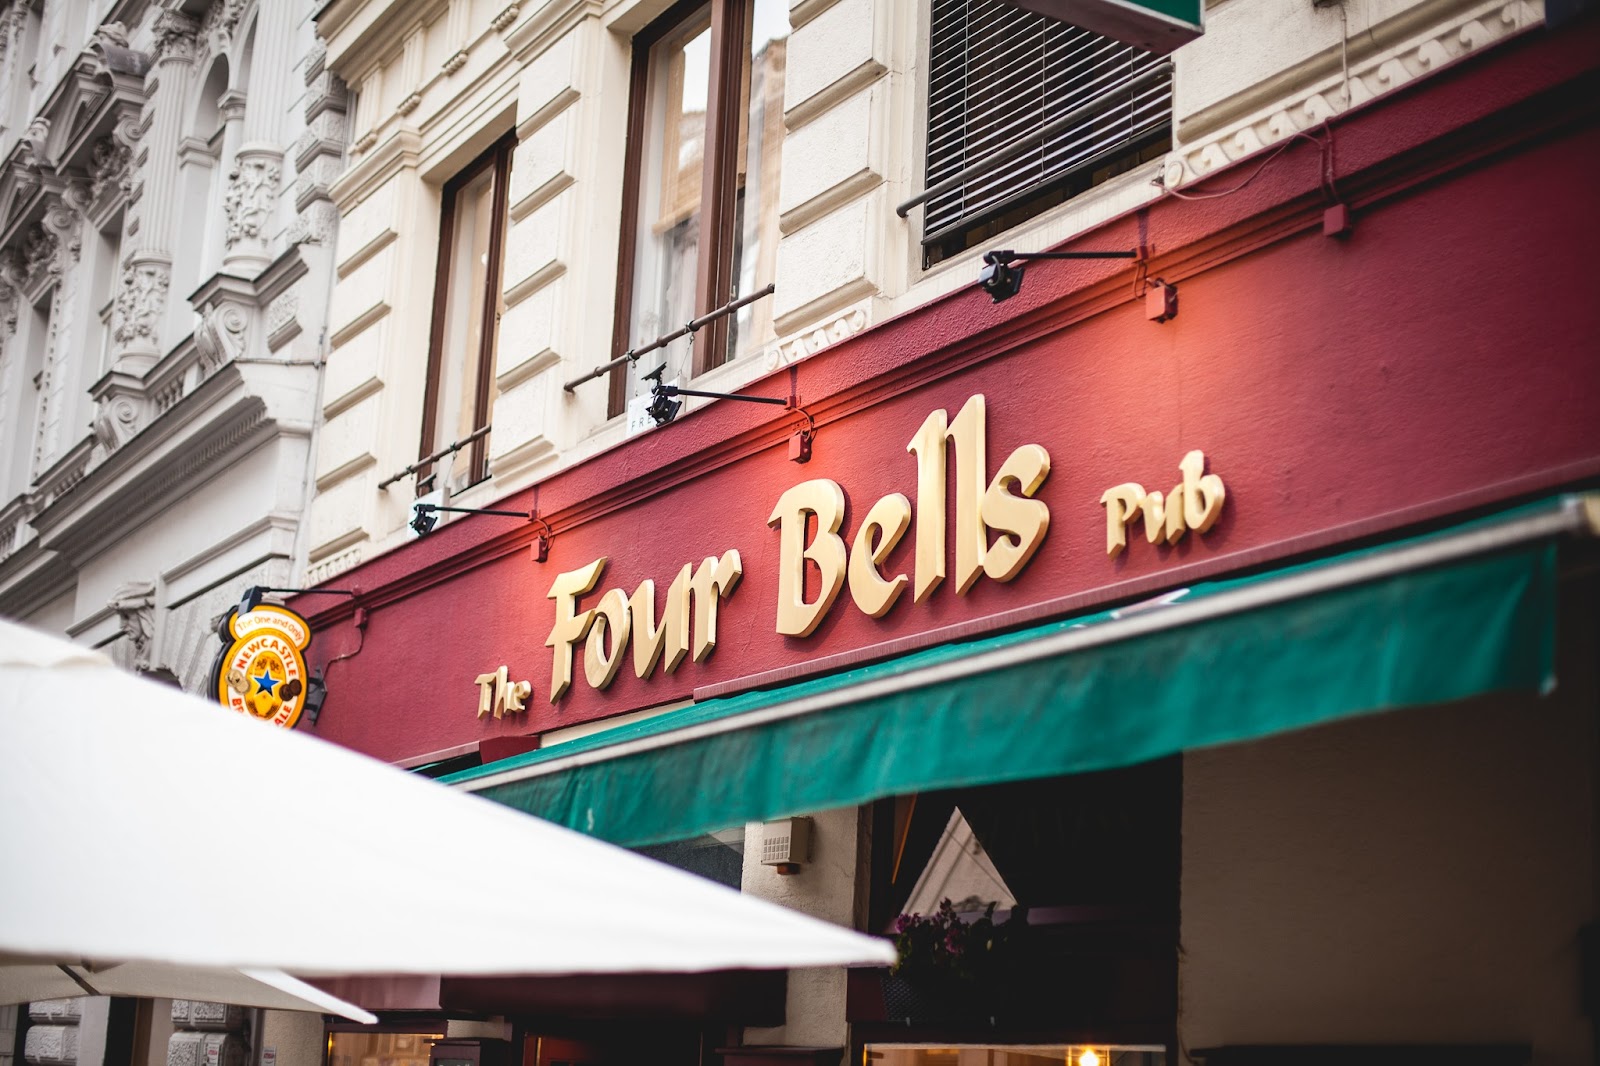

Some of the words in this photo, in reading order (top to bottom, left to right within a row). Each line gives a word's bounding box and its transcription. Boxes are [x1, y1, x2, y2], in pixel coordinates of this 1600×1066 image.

[474, 665, 532, 720] The
[544, 548, 742, 706] Four
[767, 393, 1051, 638] Bells
[1100, 449, 1226, 560] Pub
[237, 619, 253, 631] The
[254, 616, 271, 625] One
[272, 616, 289, 629] and
[288, 623, 303, 642] Only
[235, 638, 297, 677] NEWCASTLE
